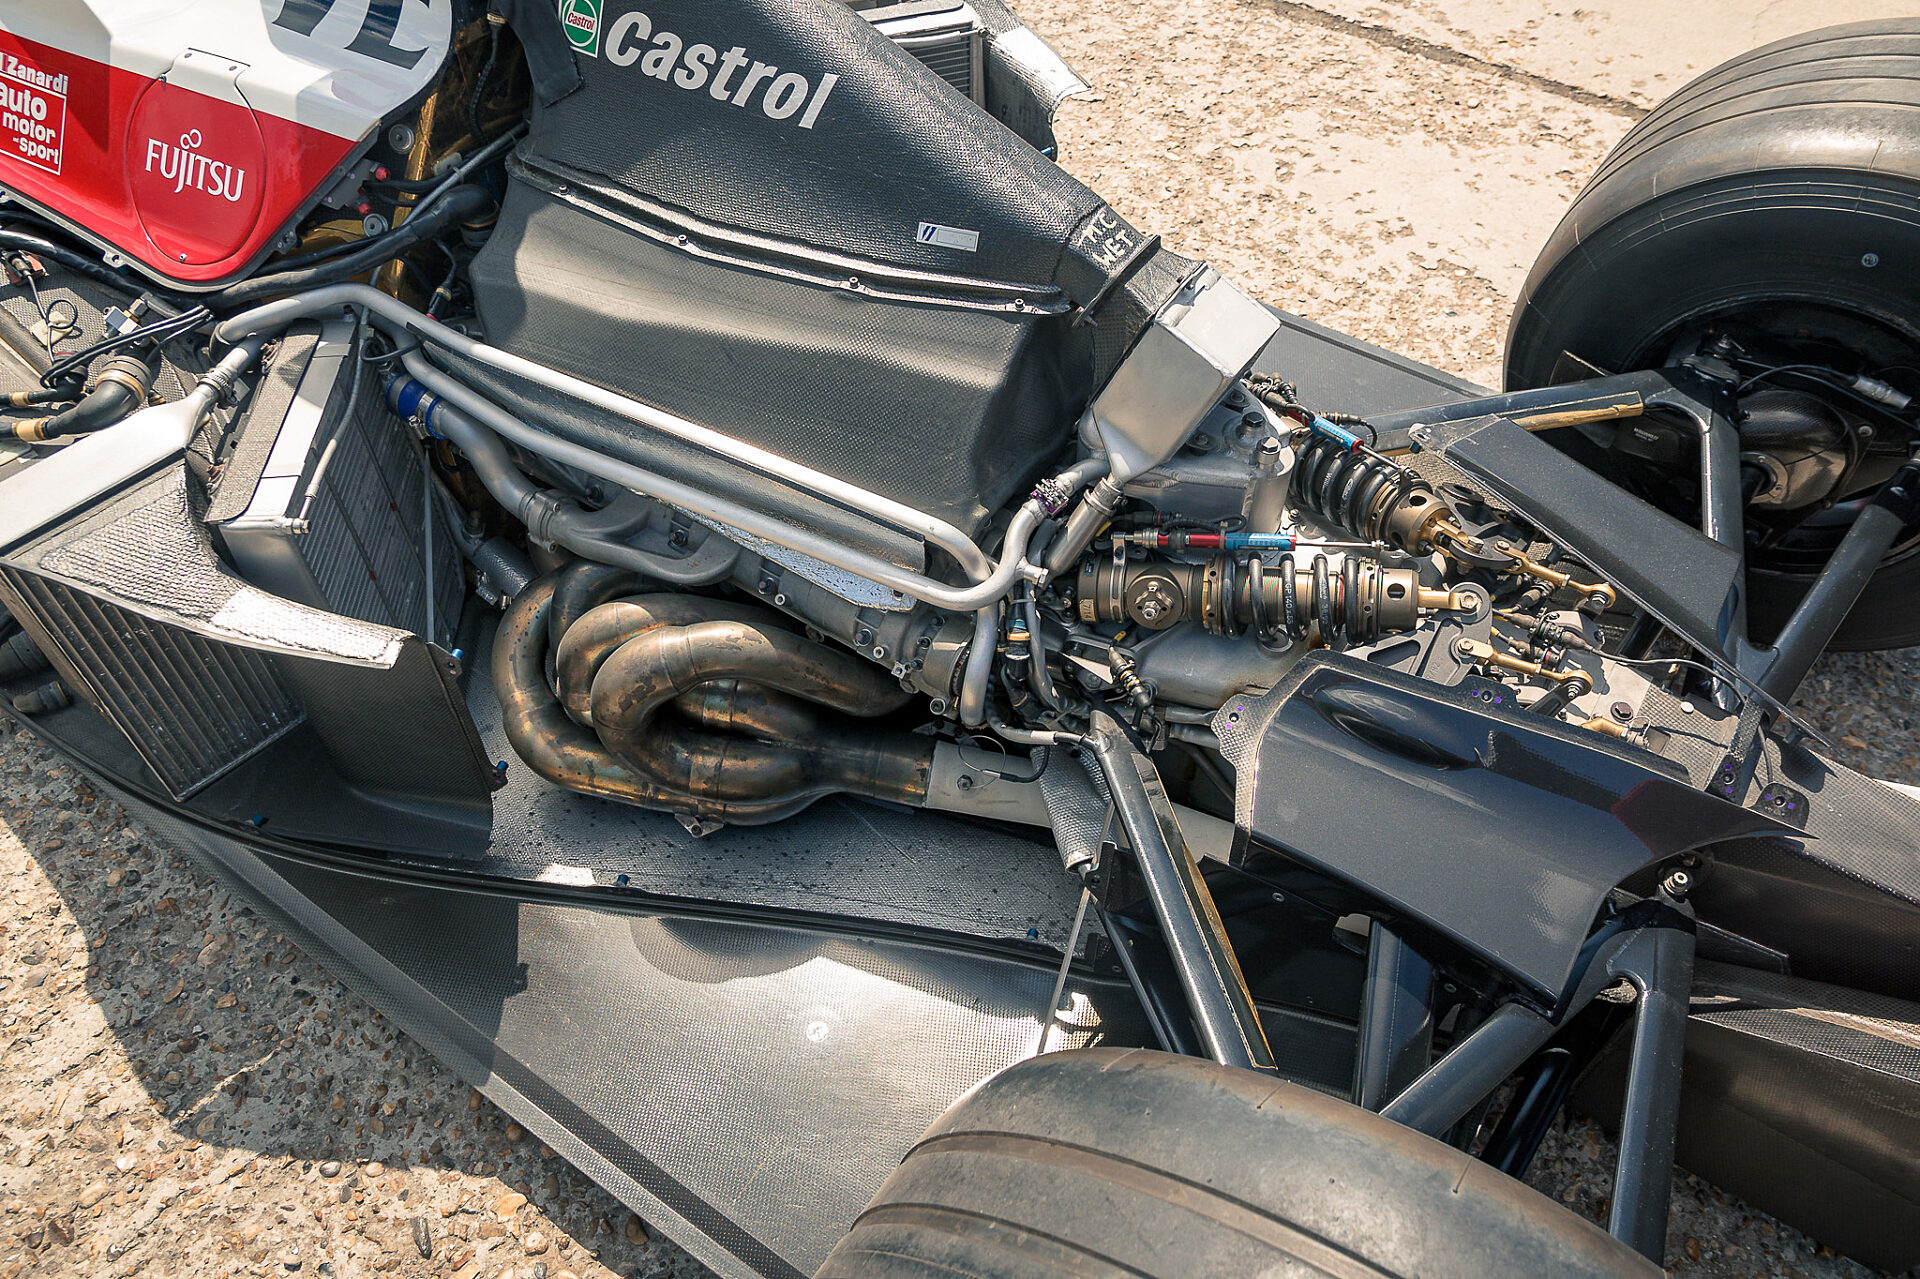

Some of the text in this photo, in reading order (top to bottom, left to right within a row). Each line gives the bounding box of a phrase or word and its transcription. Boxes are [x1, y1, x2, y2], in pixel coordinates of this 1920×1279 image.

[567, 12, 596, 31] Castrol
[6, 55, 69, 95] Zanardi
[605, 11, 840, 129] Castrol
[0, 81, 47, 121] auto
[2, 111, 56, 144] motor
[145, 138, 245, 202] FUJITSU
[1092, 229, 1134, 269] WET
